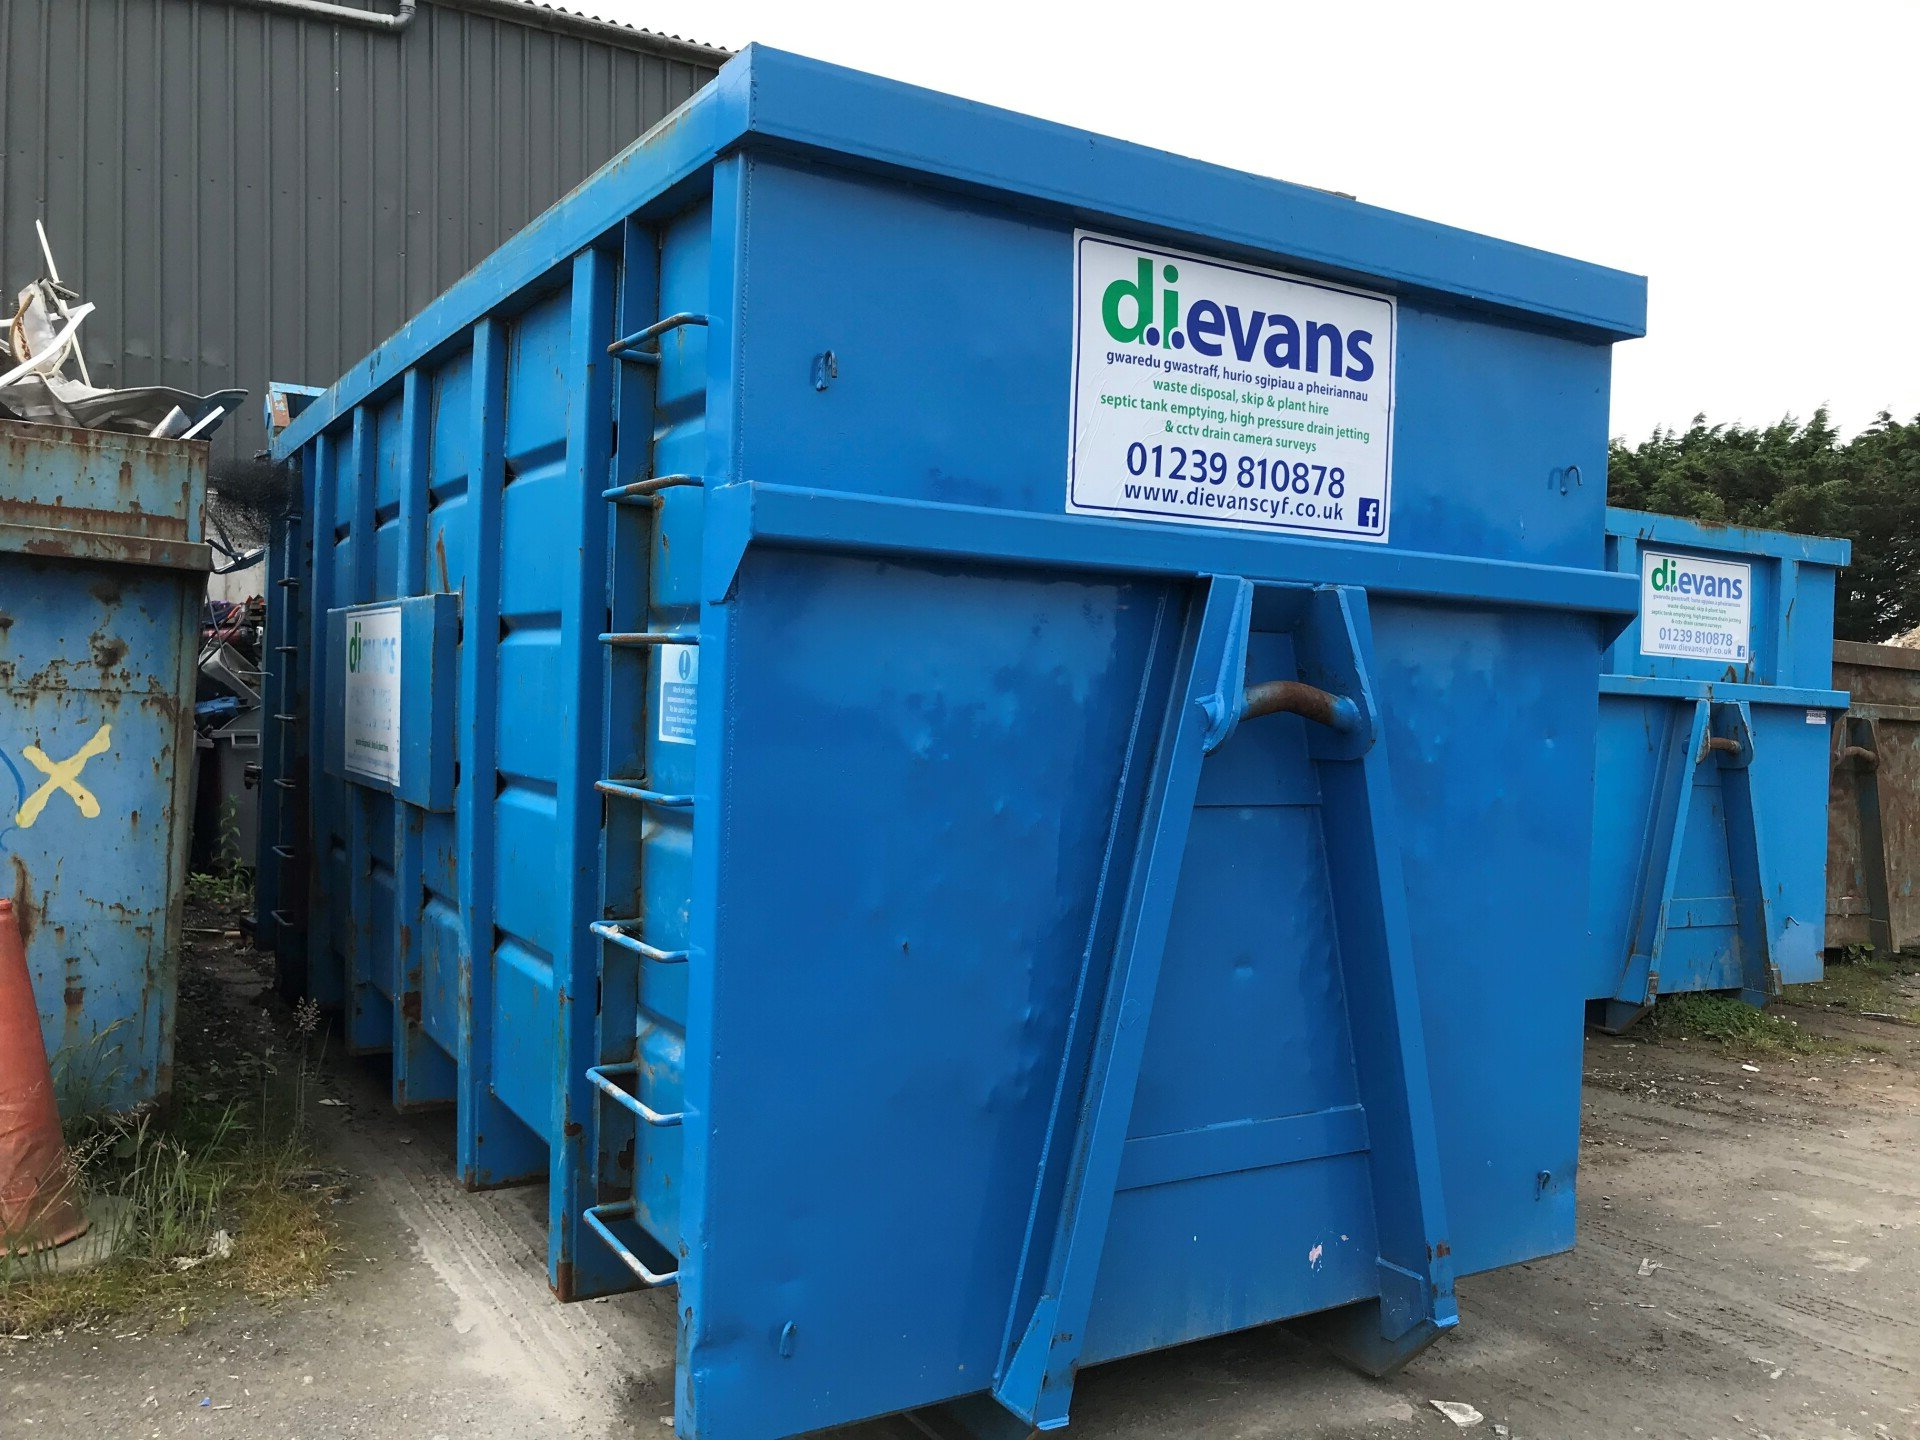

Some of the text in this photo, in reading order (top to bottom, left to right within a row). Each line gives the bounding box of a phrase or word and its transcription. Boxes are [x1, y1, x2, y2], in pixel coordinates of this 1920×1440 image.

[1106, 351, 1368, 402] gwaredu gwastraff, hurio sgipiau a pheiriannau
[1153, 380, 1329, 416] waste disposal, skip & plant hire
[1100, 394, 1370, 444] septic tank emptying, high pressure drain jetting
[1165, 420, 1317, 454] & cctv drain camera surveys
[1126, 441, 1345, 499] 01239 810878
[1124, 484, 1343, 521] www.dievanscyf.co.uk
[1659, 627, 1733, 647] 01239 810878
[1659, 643, 1732, 655] www.dievanscyf.co.uk
